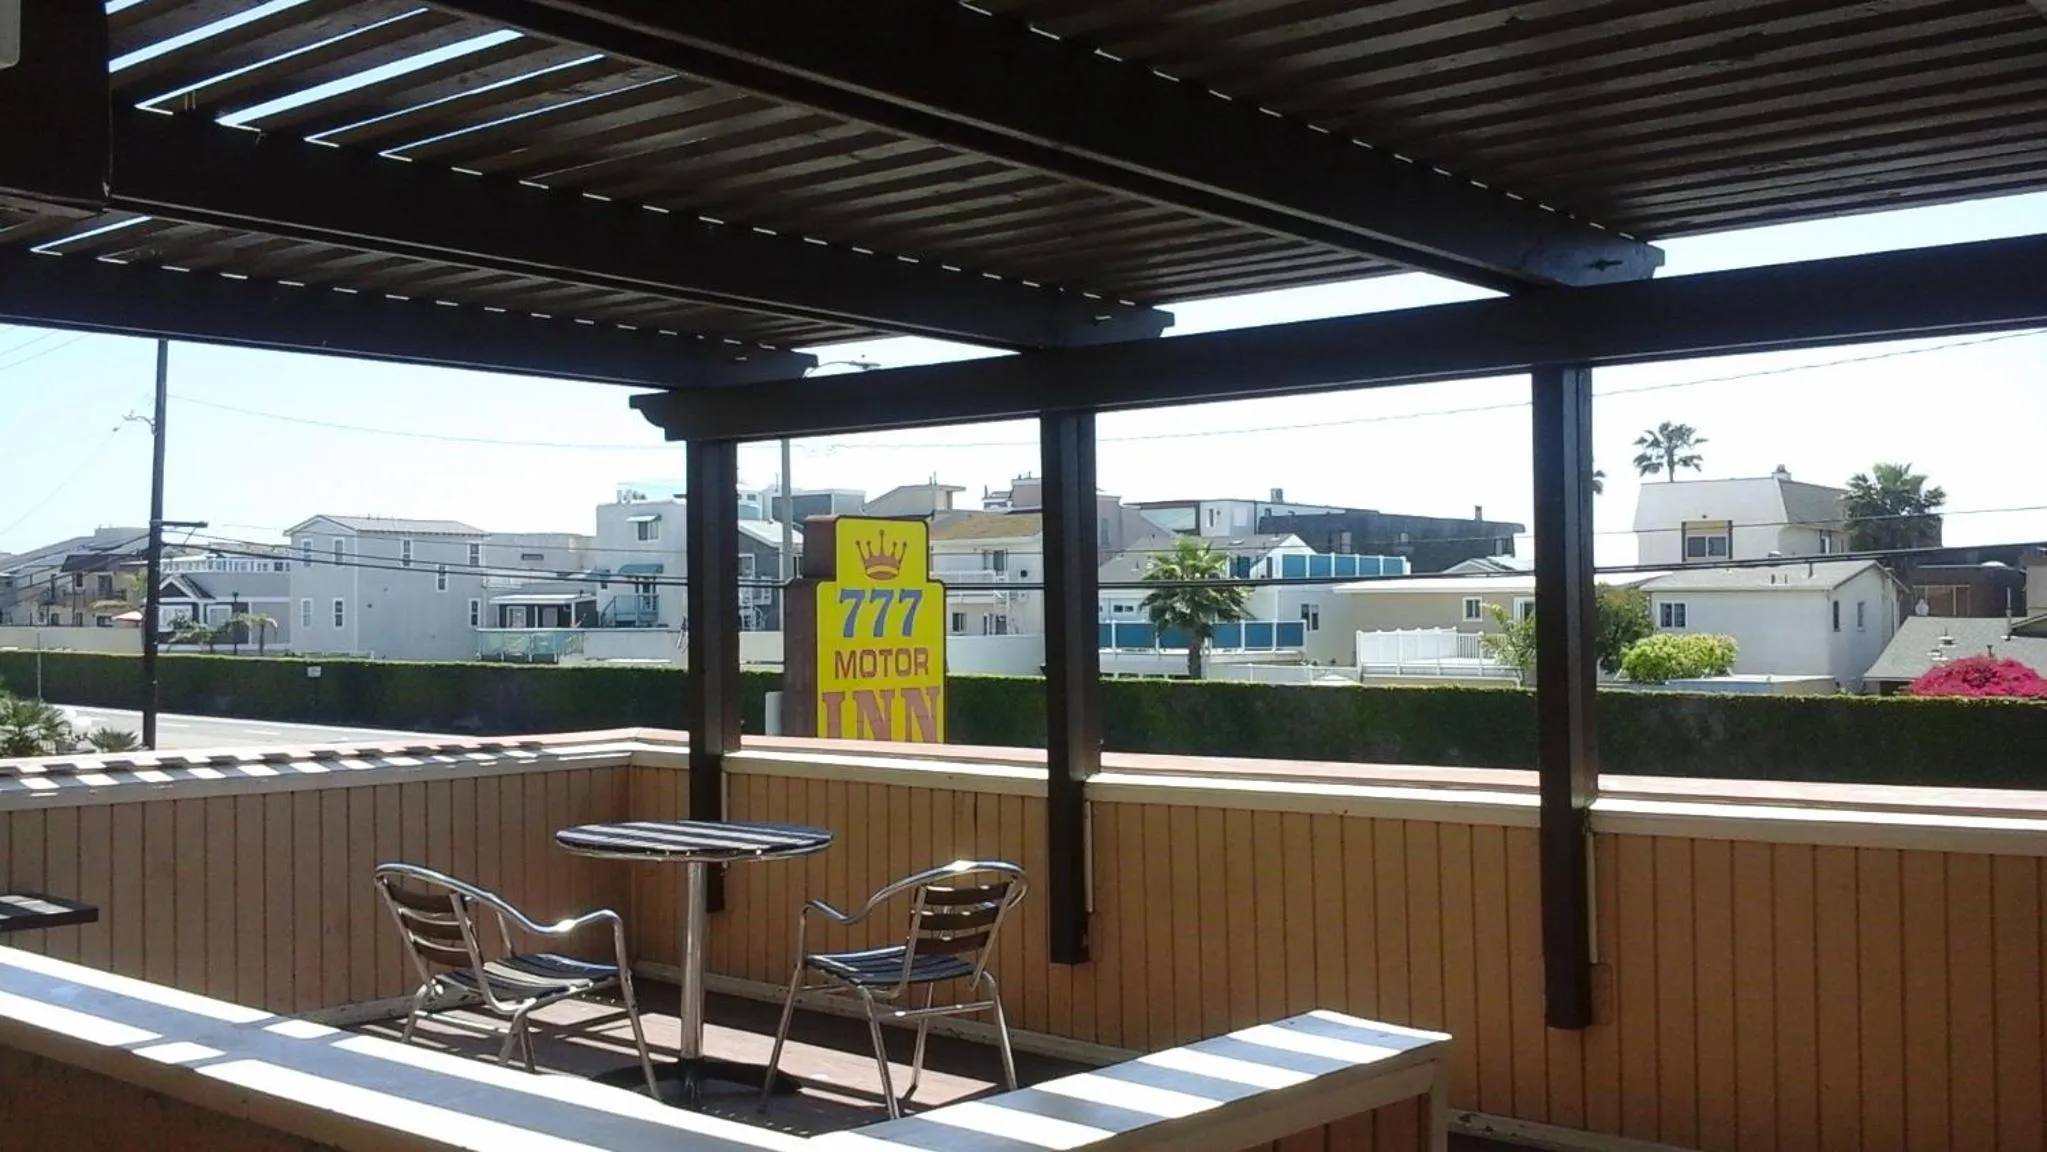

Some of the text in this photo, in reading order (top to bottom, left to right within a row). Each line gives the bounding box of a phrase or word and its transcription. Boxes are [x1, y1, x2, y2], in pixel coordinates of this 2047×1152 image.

[839, 588, 922, 638] 777
[834, 648, 929, 680] MOTOR
[822, 687, 939, 743] INN
